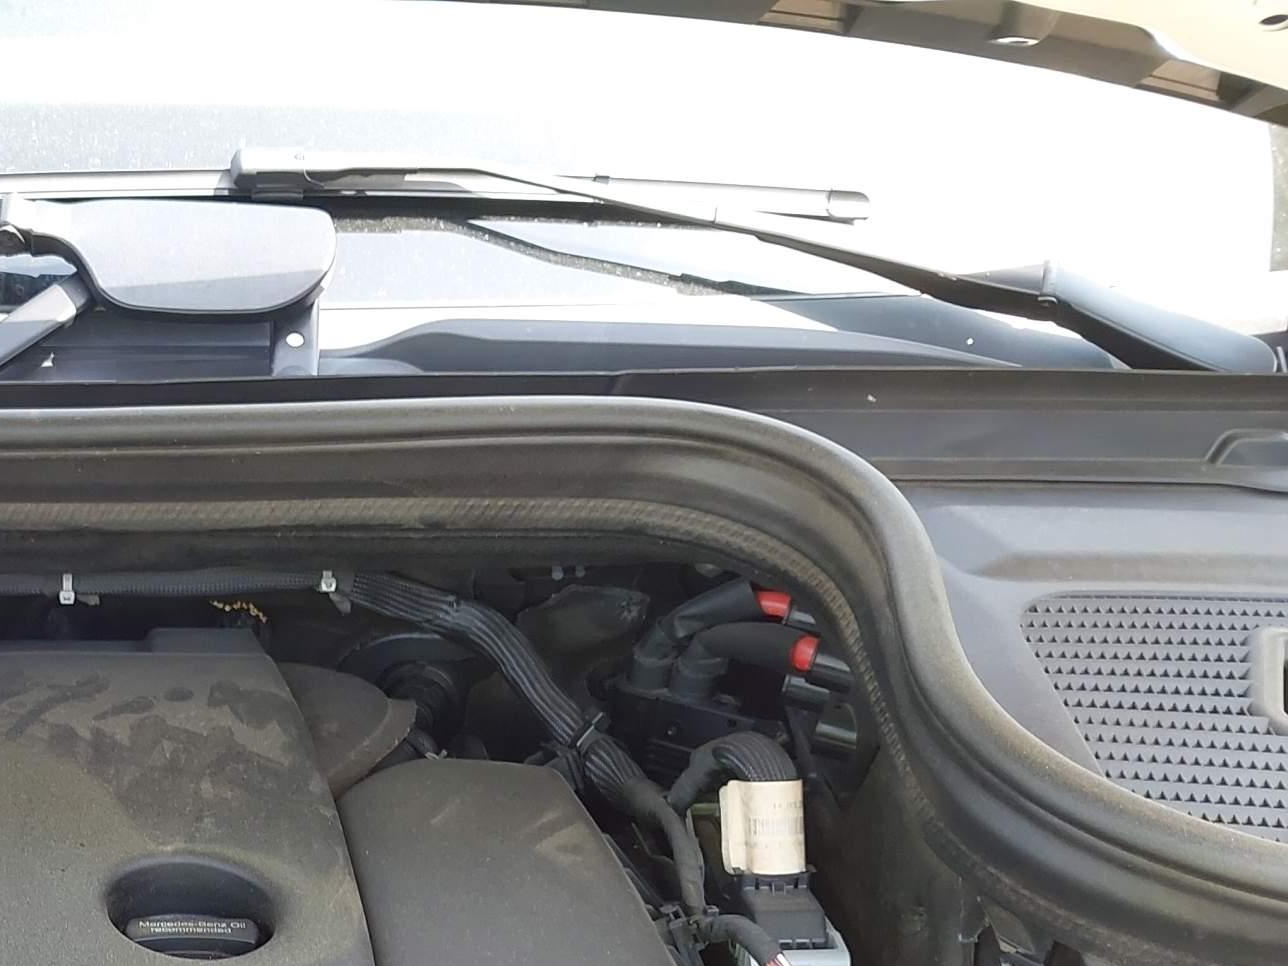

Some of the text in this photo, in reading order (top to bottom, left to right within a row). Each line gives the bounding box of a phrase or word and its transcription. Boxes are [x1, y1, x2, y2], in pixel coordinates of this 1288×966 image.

[138, 920, 246, 929] Mercedes-Benz Oil
[150, 926, 232, 934] recommended
